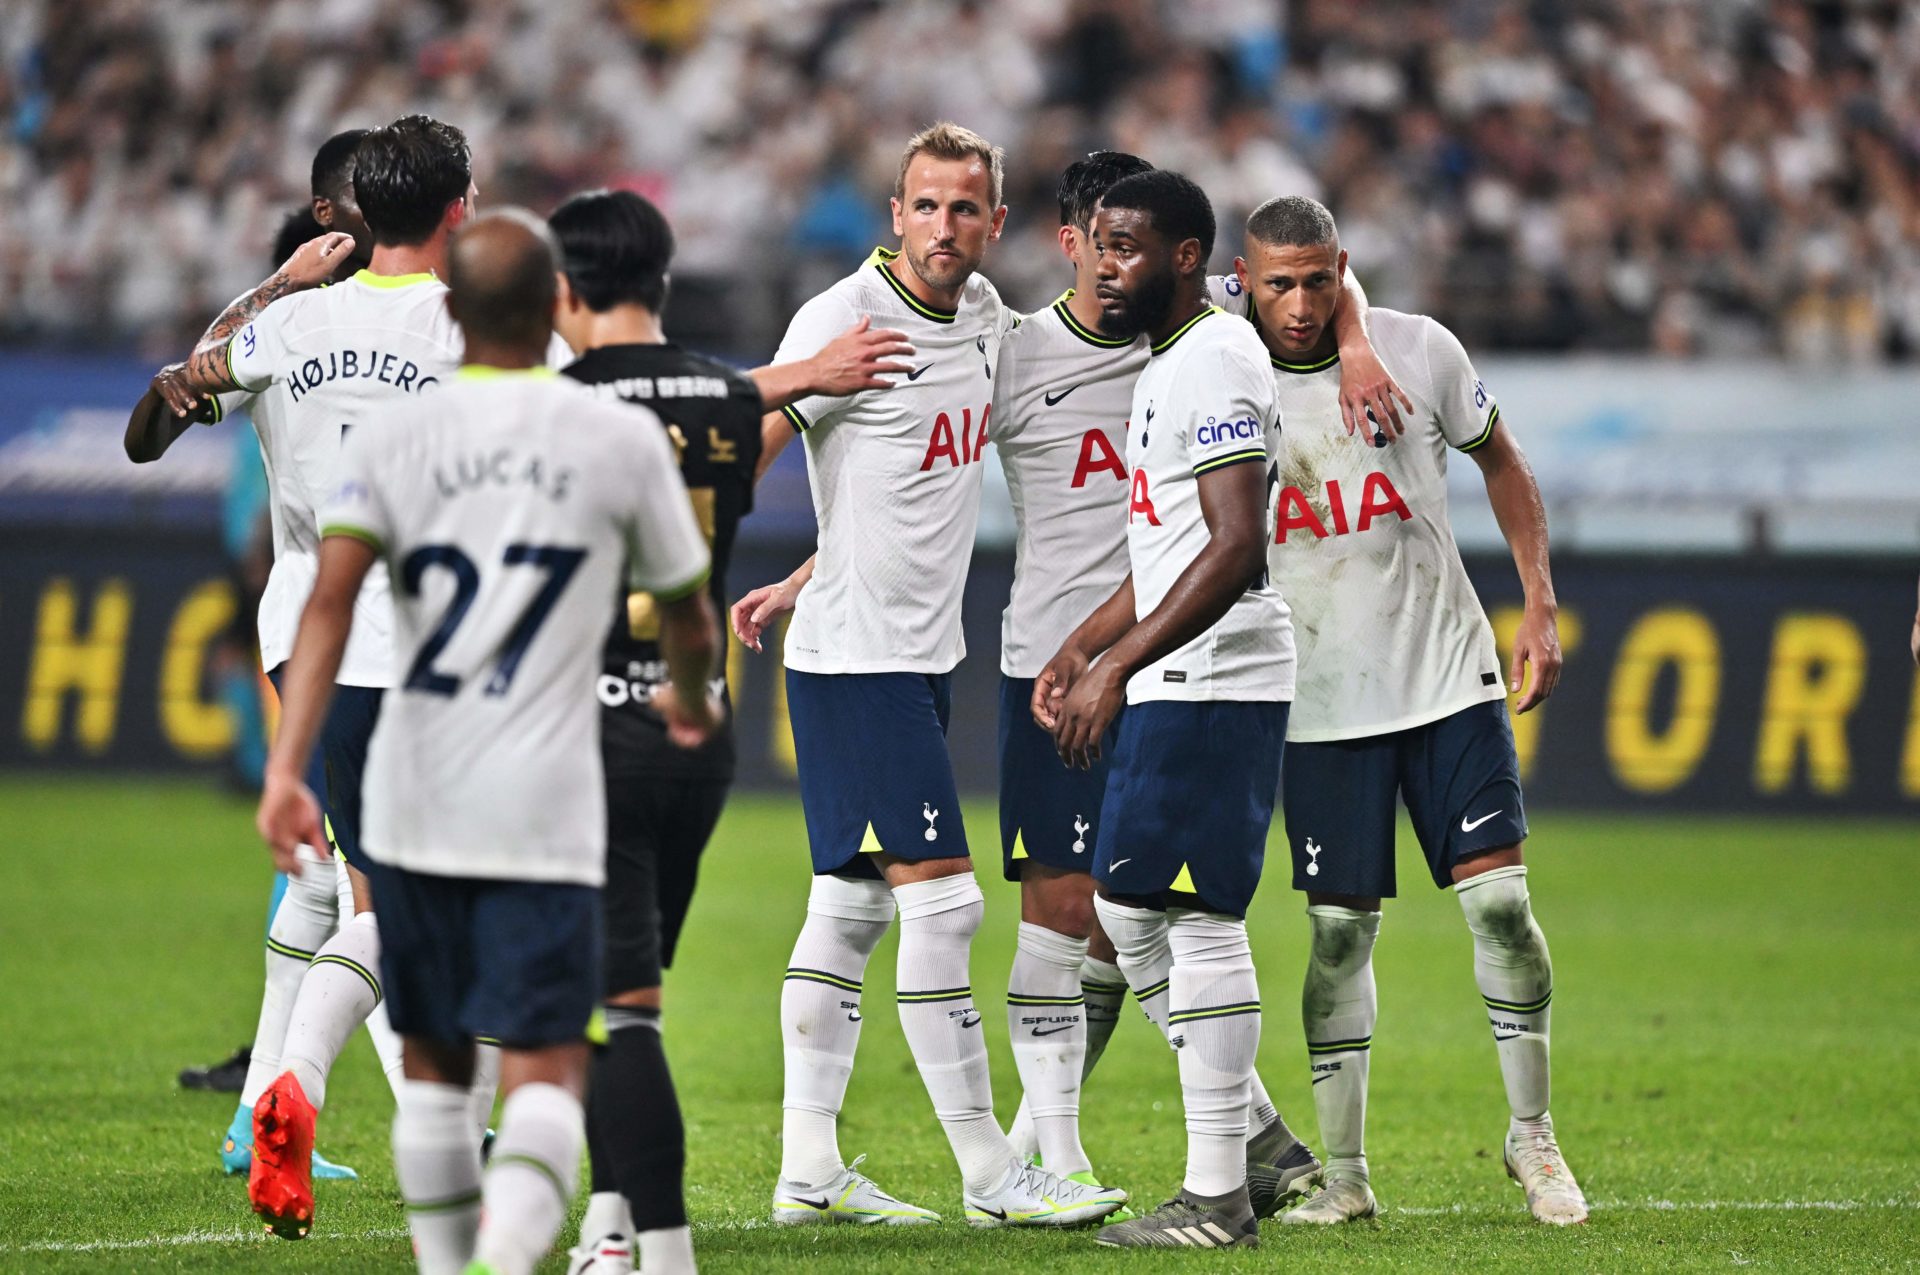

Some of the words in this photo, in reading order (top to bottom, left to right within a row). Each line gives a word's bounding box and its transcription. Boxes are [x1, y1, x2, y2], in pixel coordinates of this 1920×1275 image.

[1197, 416, 1262, 445] cinch
[433, 448, 577, 502] LUCAS
[1275, 471, 1413, 545] AIA
[401, 543, 590, 697] 27
[1022, 1016, 1080, 1025] SPURS
